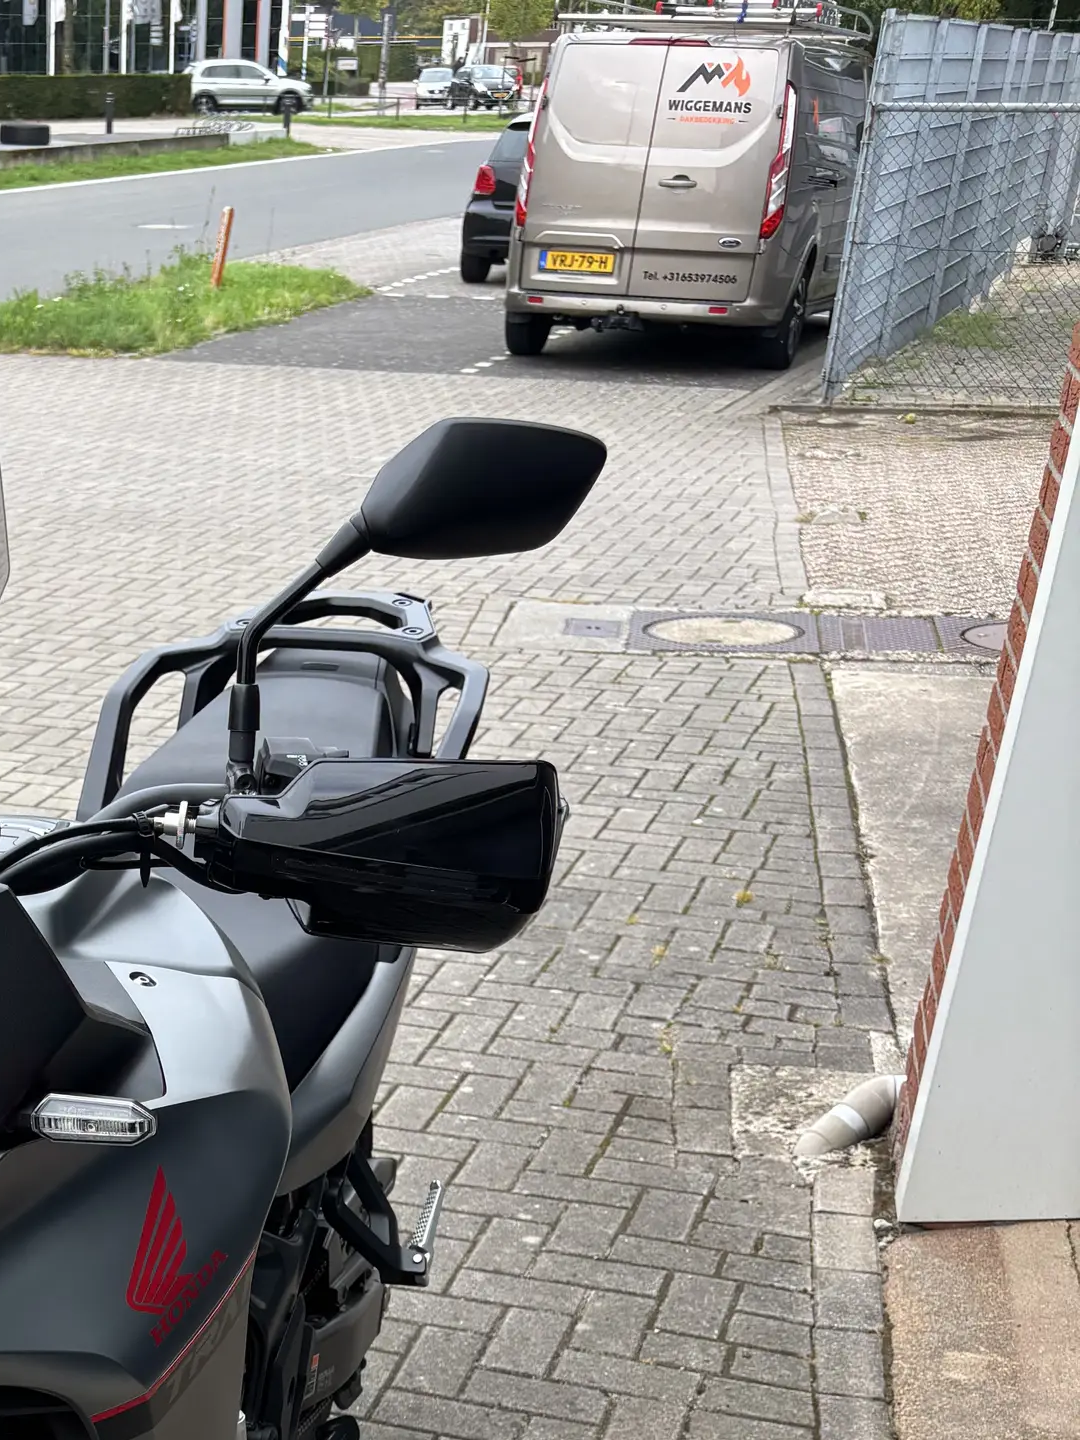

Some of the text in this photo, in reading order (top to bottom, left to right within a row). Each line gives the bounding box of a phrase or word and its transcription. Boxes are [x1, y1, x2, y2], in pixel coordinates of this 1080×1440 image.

[668, 99, 752, 114] WIGGEMANS
[551, 253, 609, 270] VRJ-79-H
[643, 270, 738, 284] Tel. +31653974506
[149, 1249, 229, 1348] HONDA
